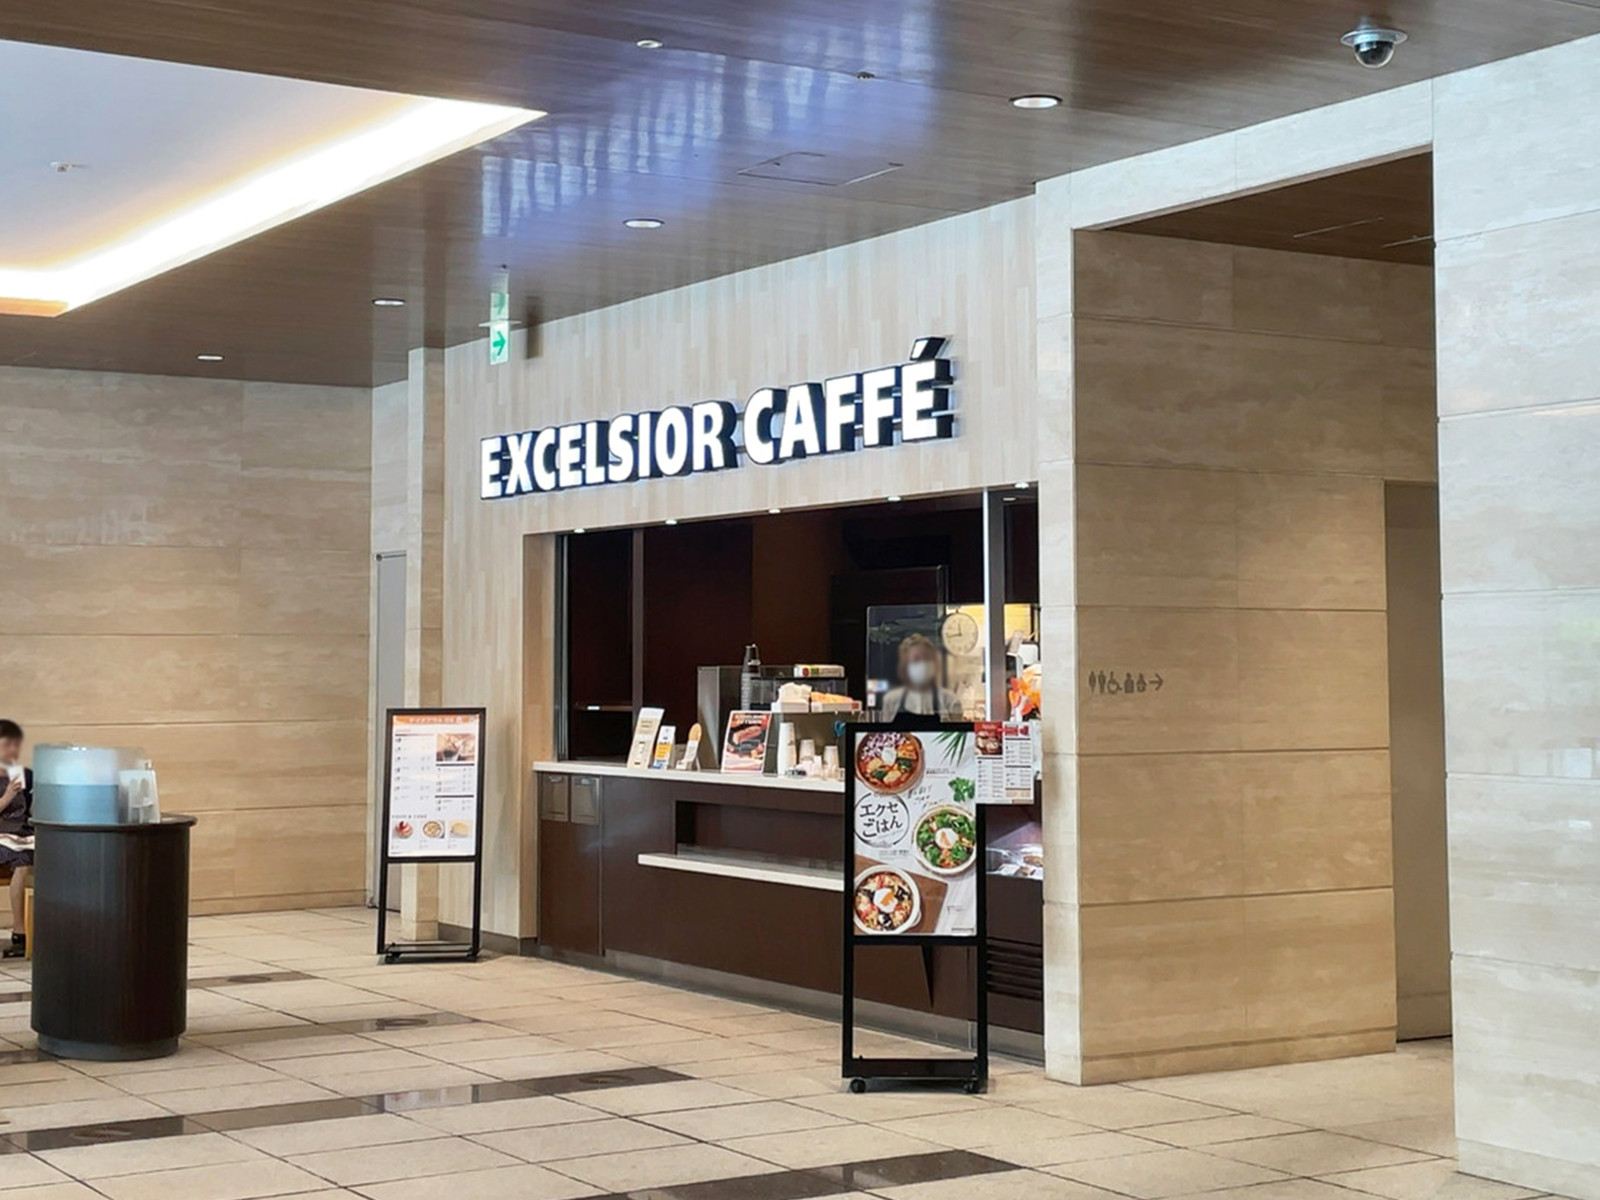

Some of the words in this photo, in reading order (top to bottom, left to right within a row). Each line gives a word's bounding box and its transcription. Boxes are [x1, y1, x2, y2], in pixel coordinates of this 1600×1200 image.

[480, 401, 731, 499] EXCELSIOR
[744, 337, 945, 465] CAFFÉ
[860, 802, 898, 817] エクセ
[863, 816, 903, 838] ごはん
